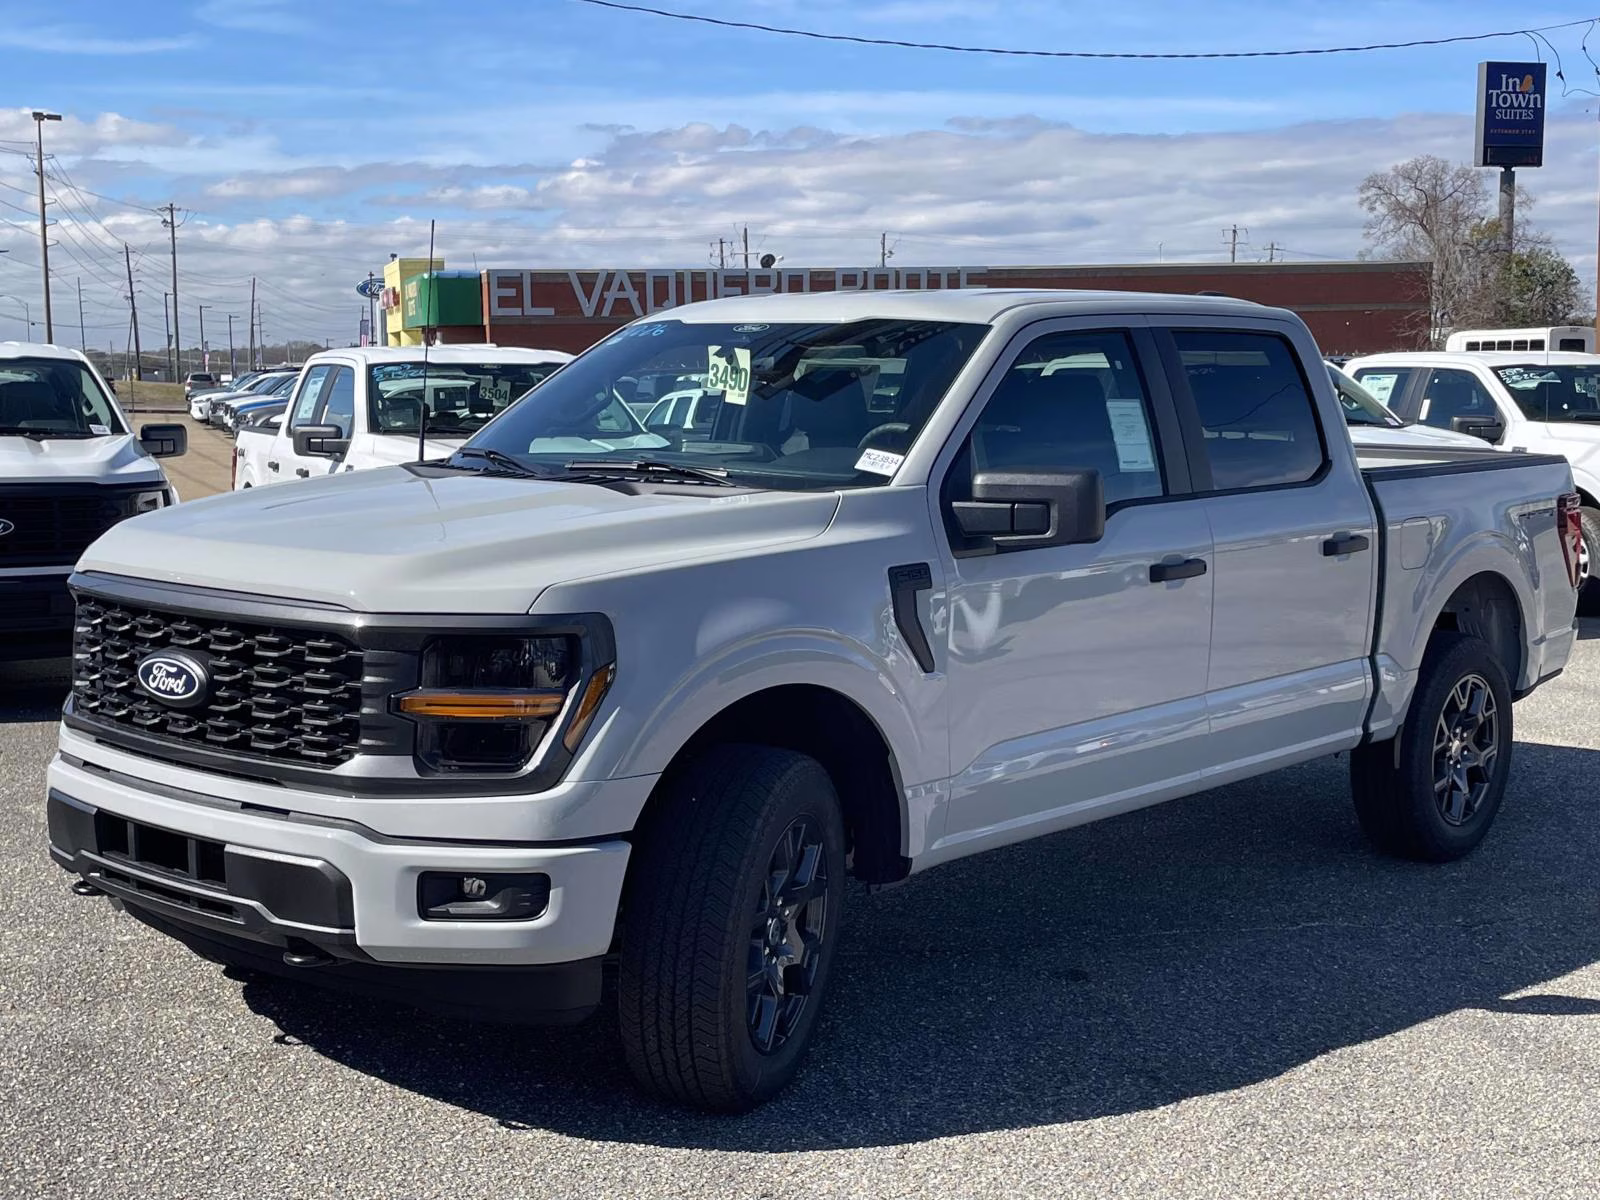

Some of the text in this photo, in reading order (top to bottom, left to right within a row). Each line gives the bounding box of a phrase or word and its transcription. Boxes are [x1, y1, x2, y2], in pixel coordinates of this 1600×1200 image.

[1501, 74, 1520, 92] In
[1488, 89, 1542, 108] Town
[1495, 109, 1534, 120] SUITES
[490, 269, 555, 316] EL
[709, 363, 748, 392] 3490
[480, 386, 508, 401] 3504
[148, 662, 187, 694] Ford
